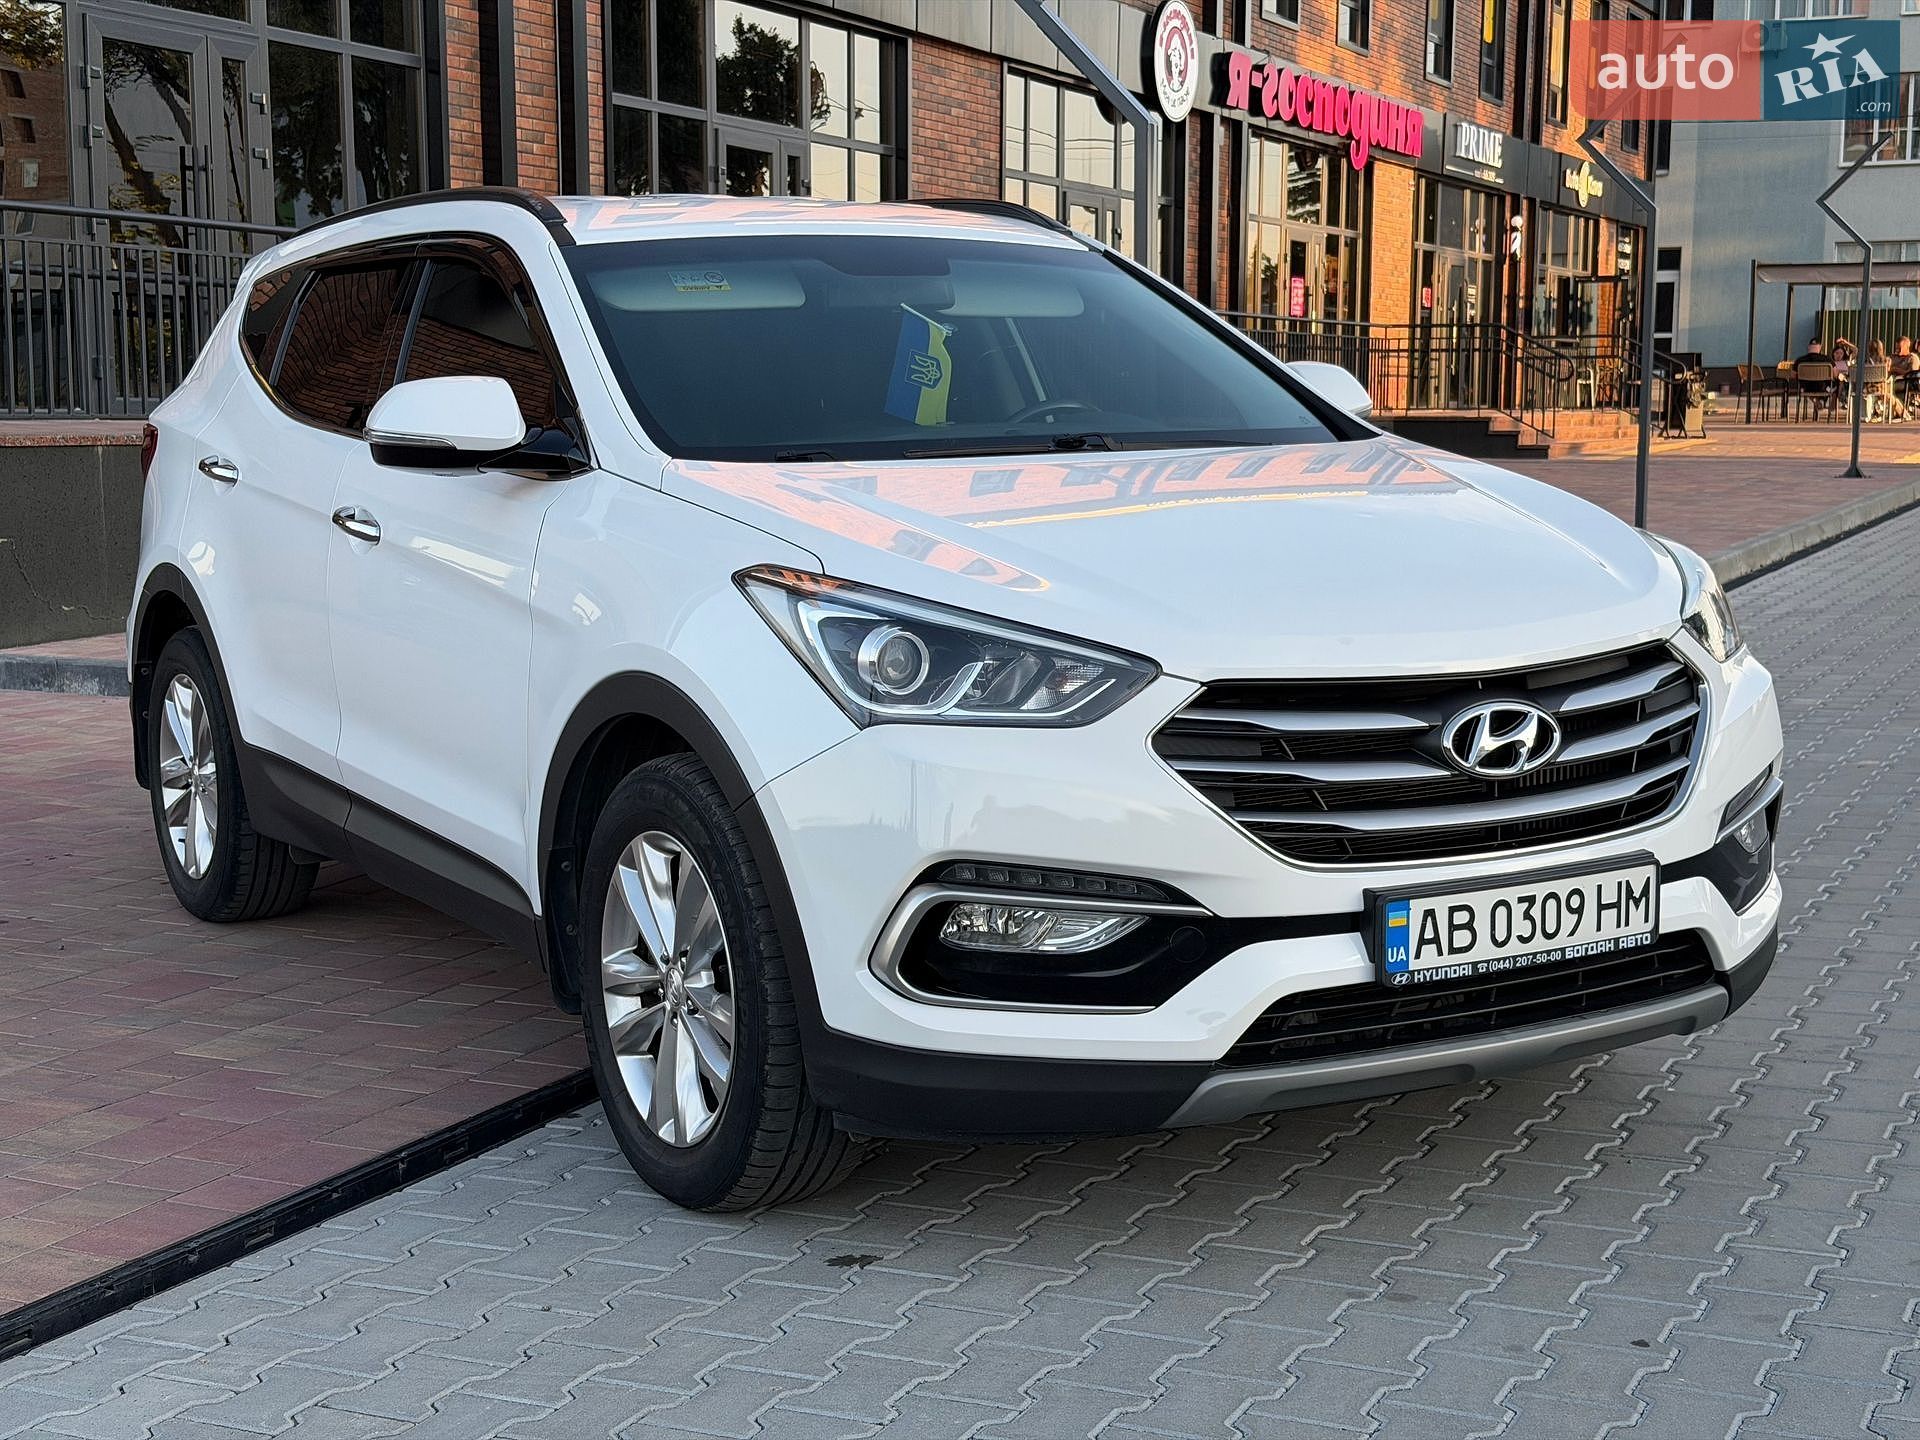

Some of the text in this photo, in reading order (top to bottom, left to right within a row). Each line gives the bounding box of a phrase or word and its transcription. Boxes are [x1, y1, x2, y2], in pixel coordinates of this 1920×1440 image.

[1456, 122, 1503, 169] PRIME
[1414, 876, 1651, 961] AB 0309 HM
[1388, 946, 1407, 963] UA
[1414, 933, 1651, 983] HYUNDAI (044) 207-50-00 БОГДАН АВТО
